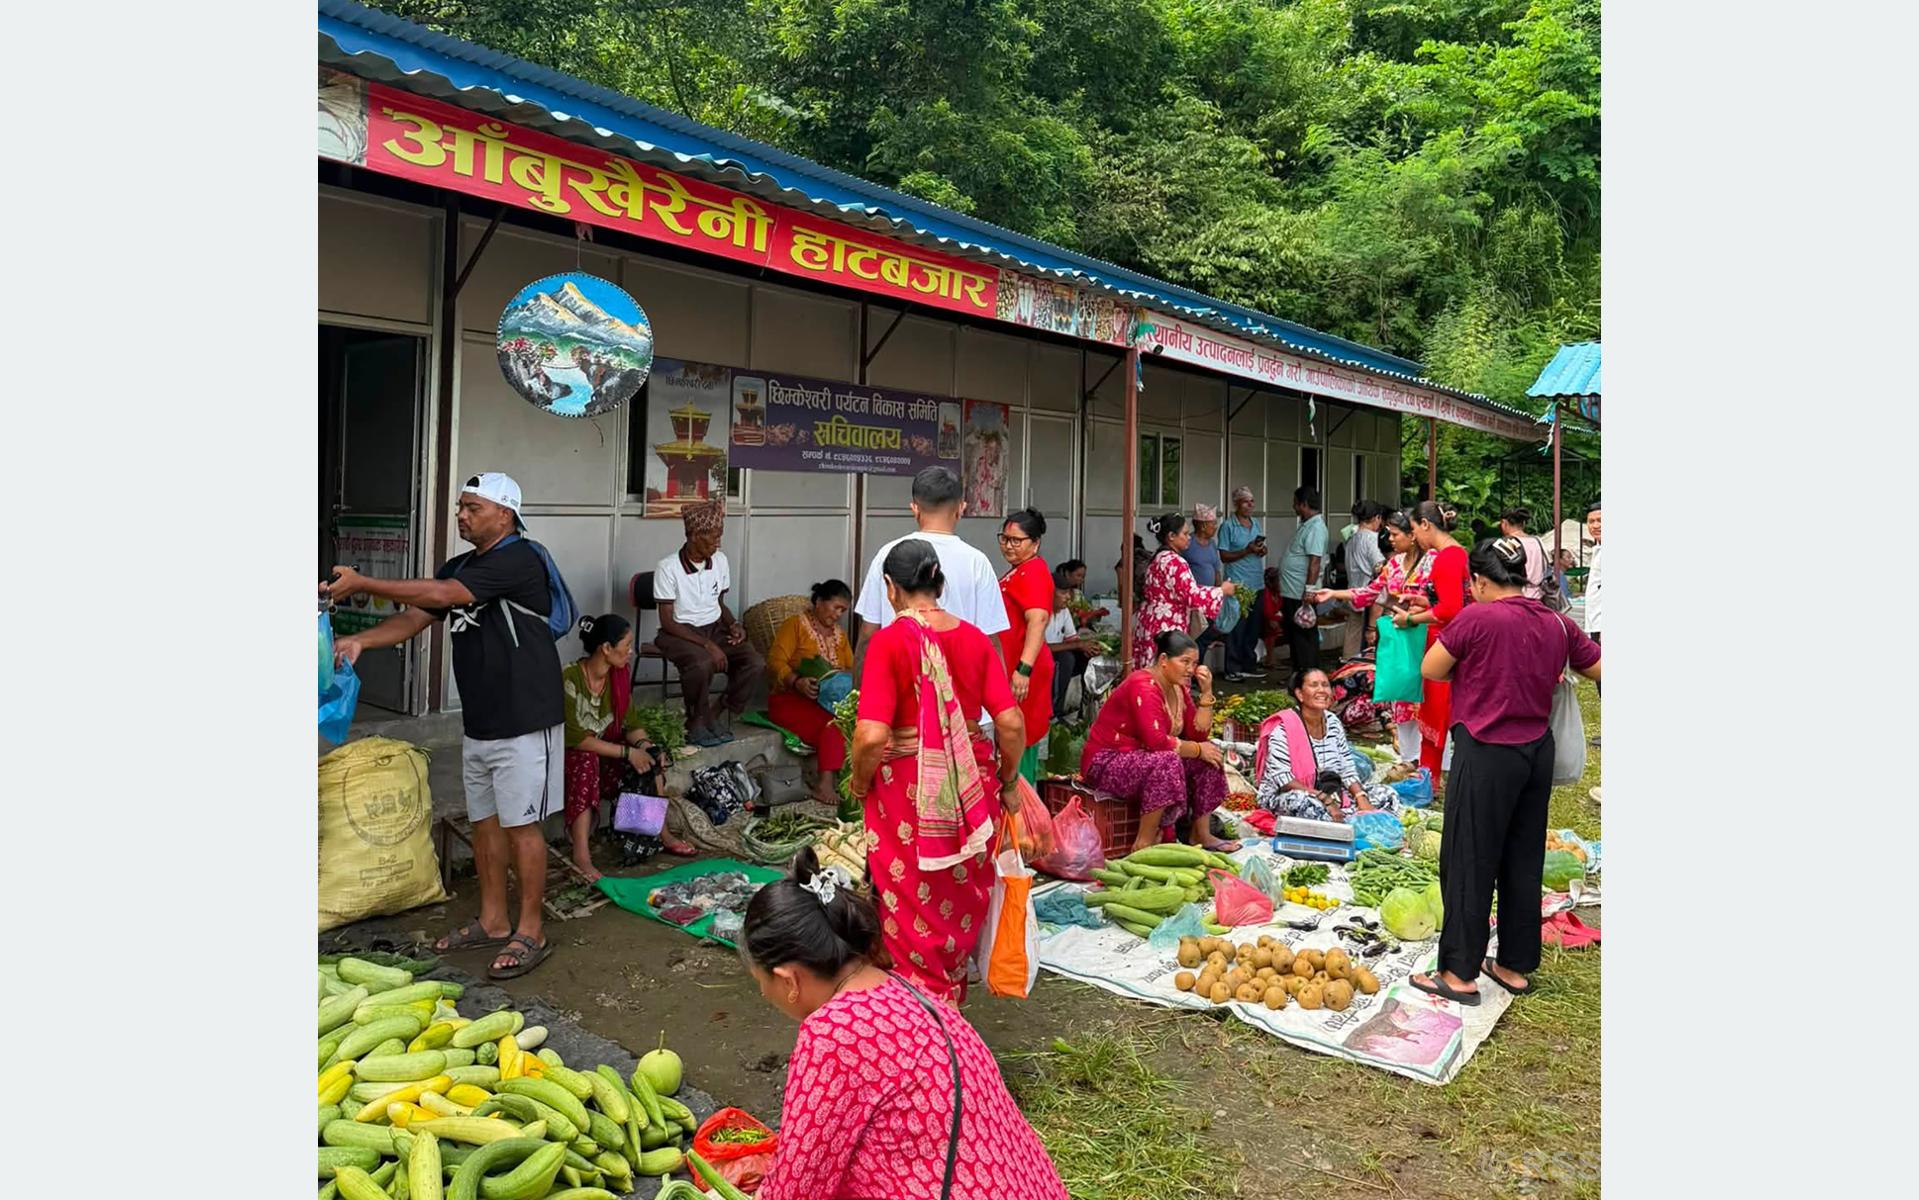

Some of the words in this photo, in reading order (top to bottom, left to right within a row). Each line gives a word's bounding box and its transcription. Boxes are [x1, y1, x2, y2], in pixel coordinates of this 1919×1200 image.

[382, 106, 774, 253] आँबुखैरेनी
[789, 225, 993, 309] हाटबजार
[835, 391, 870, 414] पर्यटन
[872, 393, 905, 417] विकास
[907, 398, 938, 422] समिति
[814, 414, 902, 450] सचिवालय
